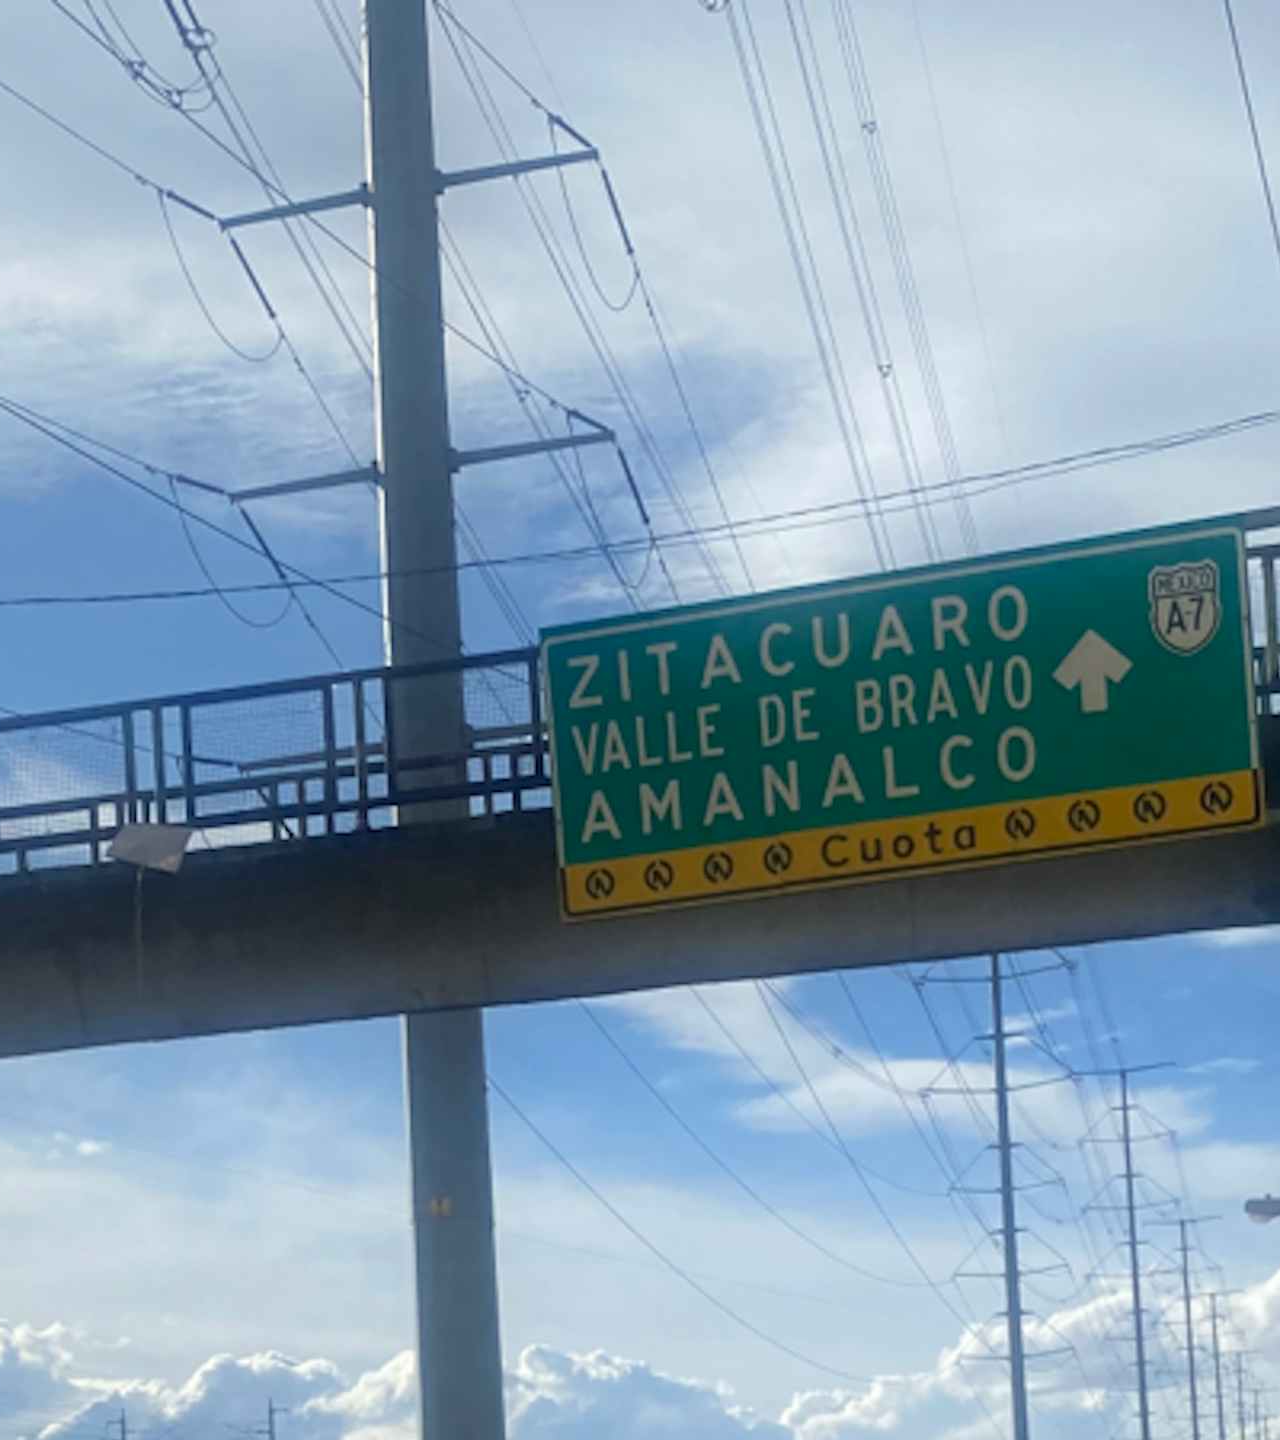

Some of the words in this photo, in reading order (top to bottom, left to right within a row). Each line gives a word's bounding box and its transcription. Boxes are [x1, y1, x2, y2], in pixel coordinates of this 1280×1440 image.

[567, 584, 1029, 709] ZITACUARO
[1166, 595, 1205, 635] A-7
[571, 703, 725, 776] VALLE
[759, 688, 820, 748] DE
[855, 654, 1033, 734] BRAVO
[581, 725, 1037, 844] AMANALCO
[821, 821, 977, 868] Cuota
